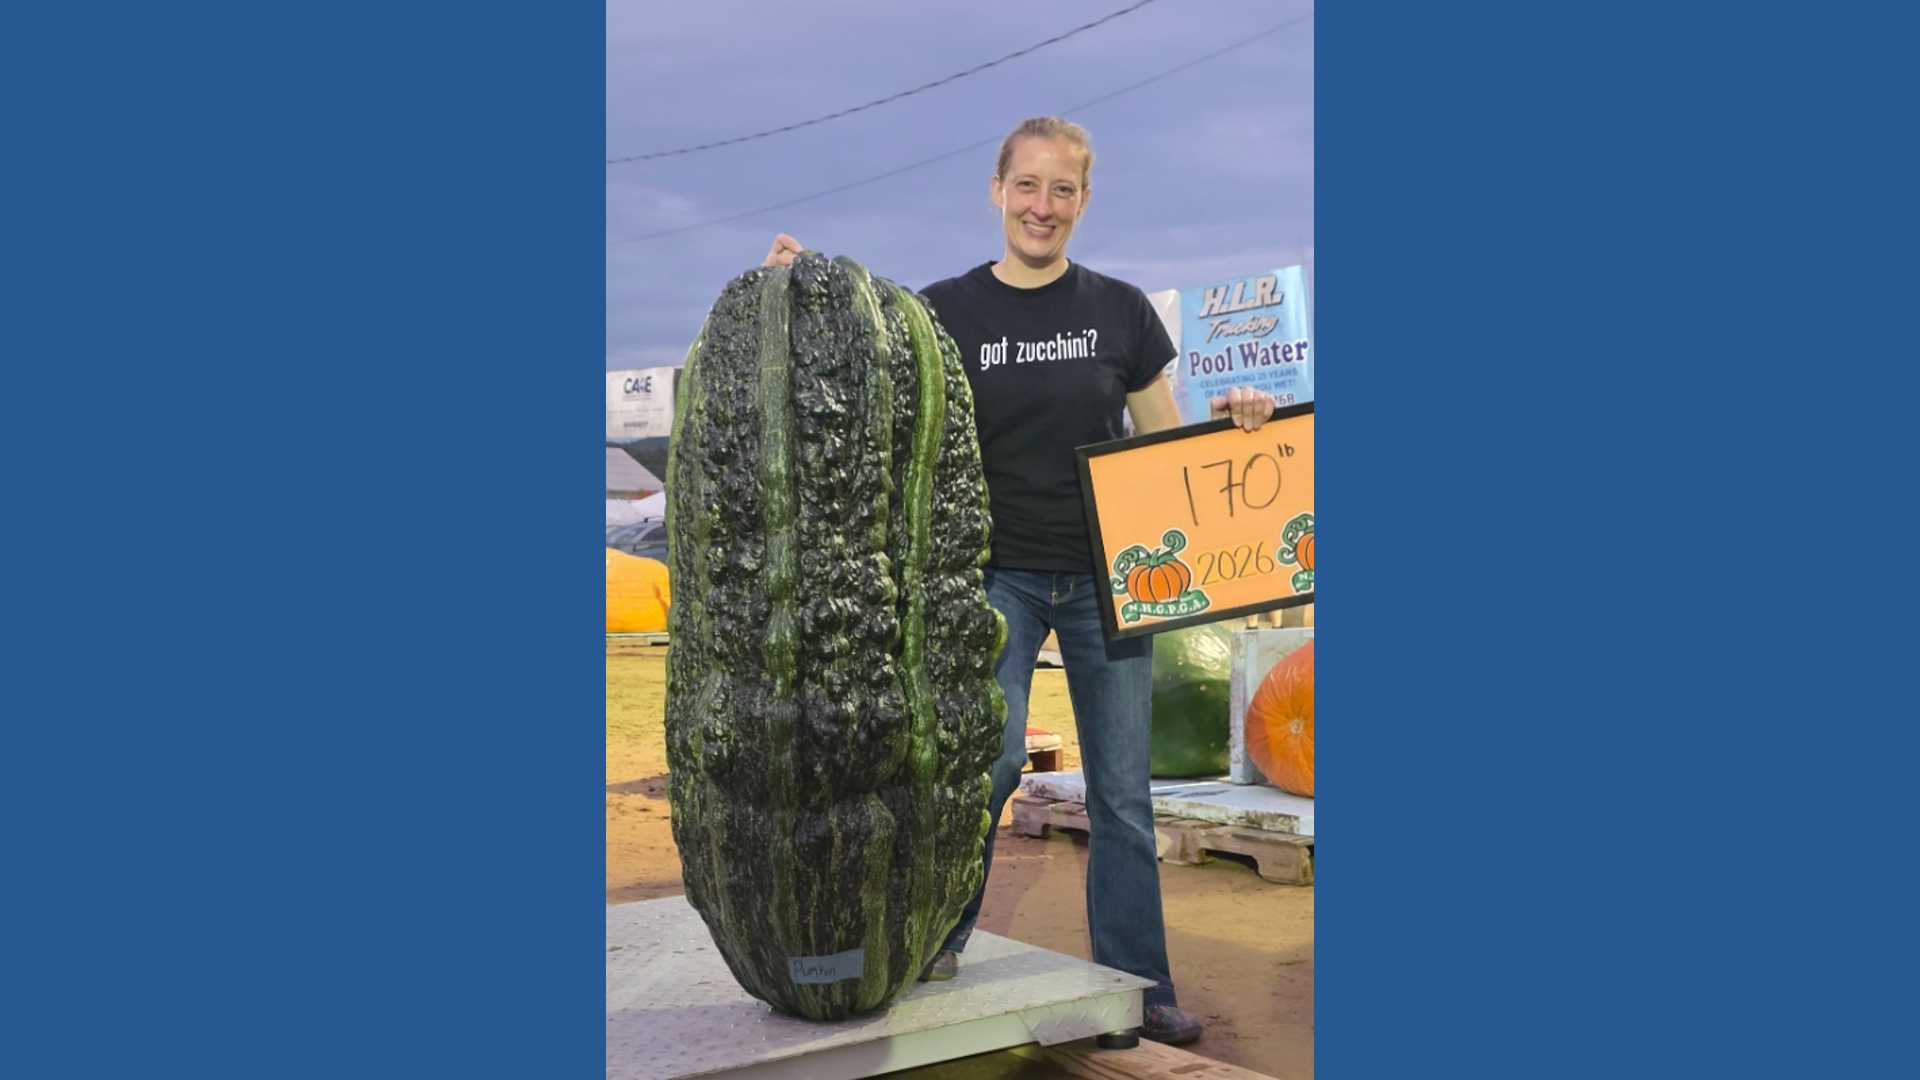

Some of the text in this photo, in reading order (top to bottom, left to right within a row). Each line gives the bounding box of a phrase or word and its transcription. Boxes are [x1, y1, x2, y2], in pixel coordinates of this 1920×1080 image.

[1198, 275, 1284, 319] H.L.R.
[1205, 315, 1279, 343] Trucking
[980, 329, 1098, 371] got zucchini?
[1189, 346, 1234, 376] Pool
[1238, 340, 1308, 369] Water
[1200, 373, 1256, 388] CELEBRATING
[1269, 367, 1299, 379] YEARS
[1204, 390, 1215, 399] OF
[1183, 443, 1295, 526] 170 lb
[1197, 541, 1275, 586] 2026
[1128, 599, 1206, 615] N.H.G.P.G.A.
